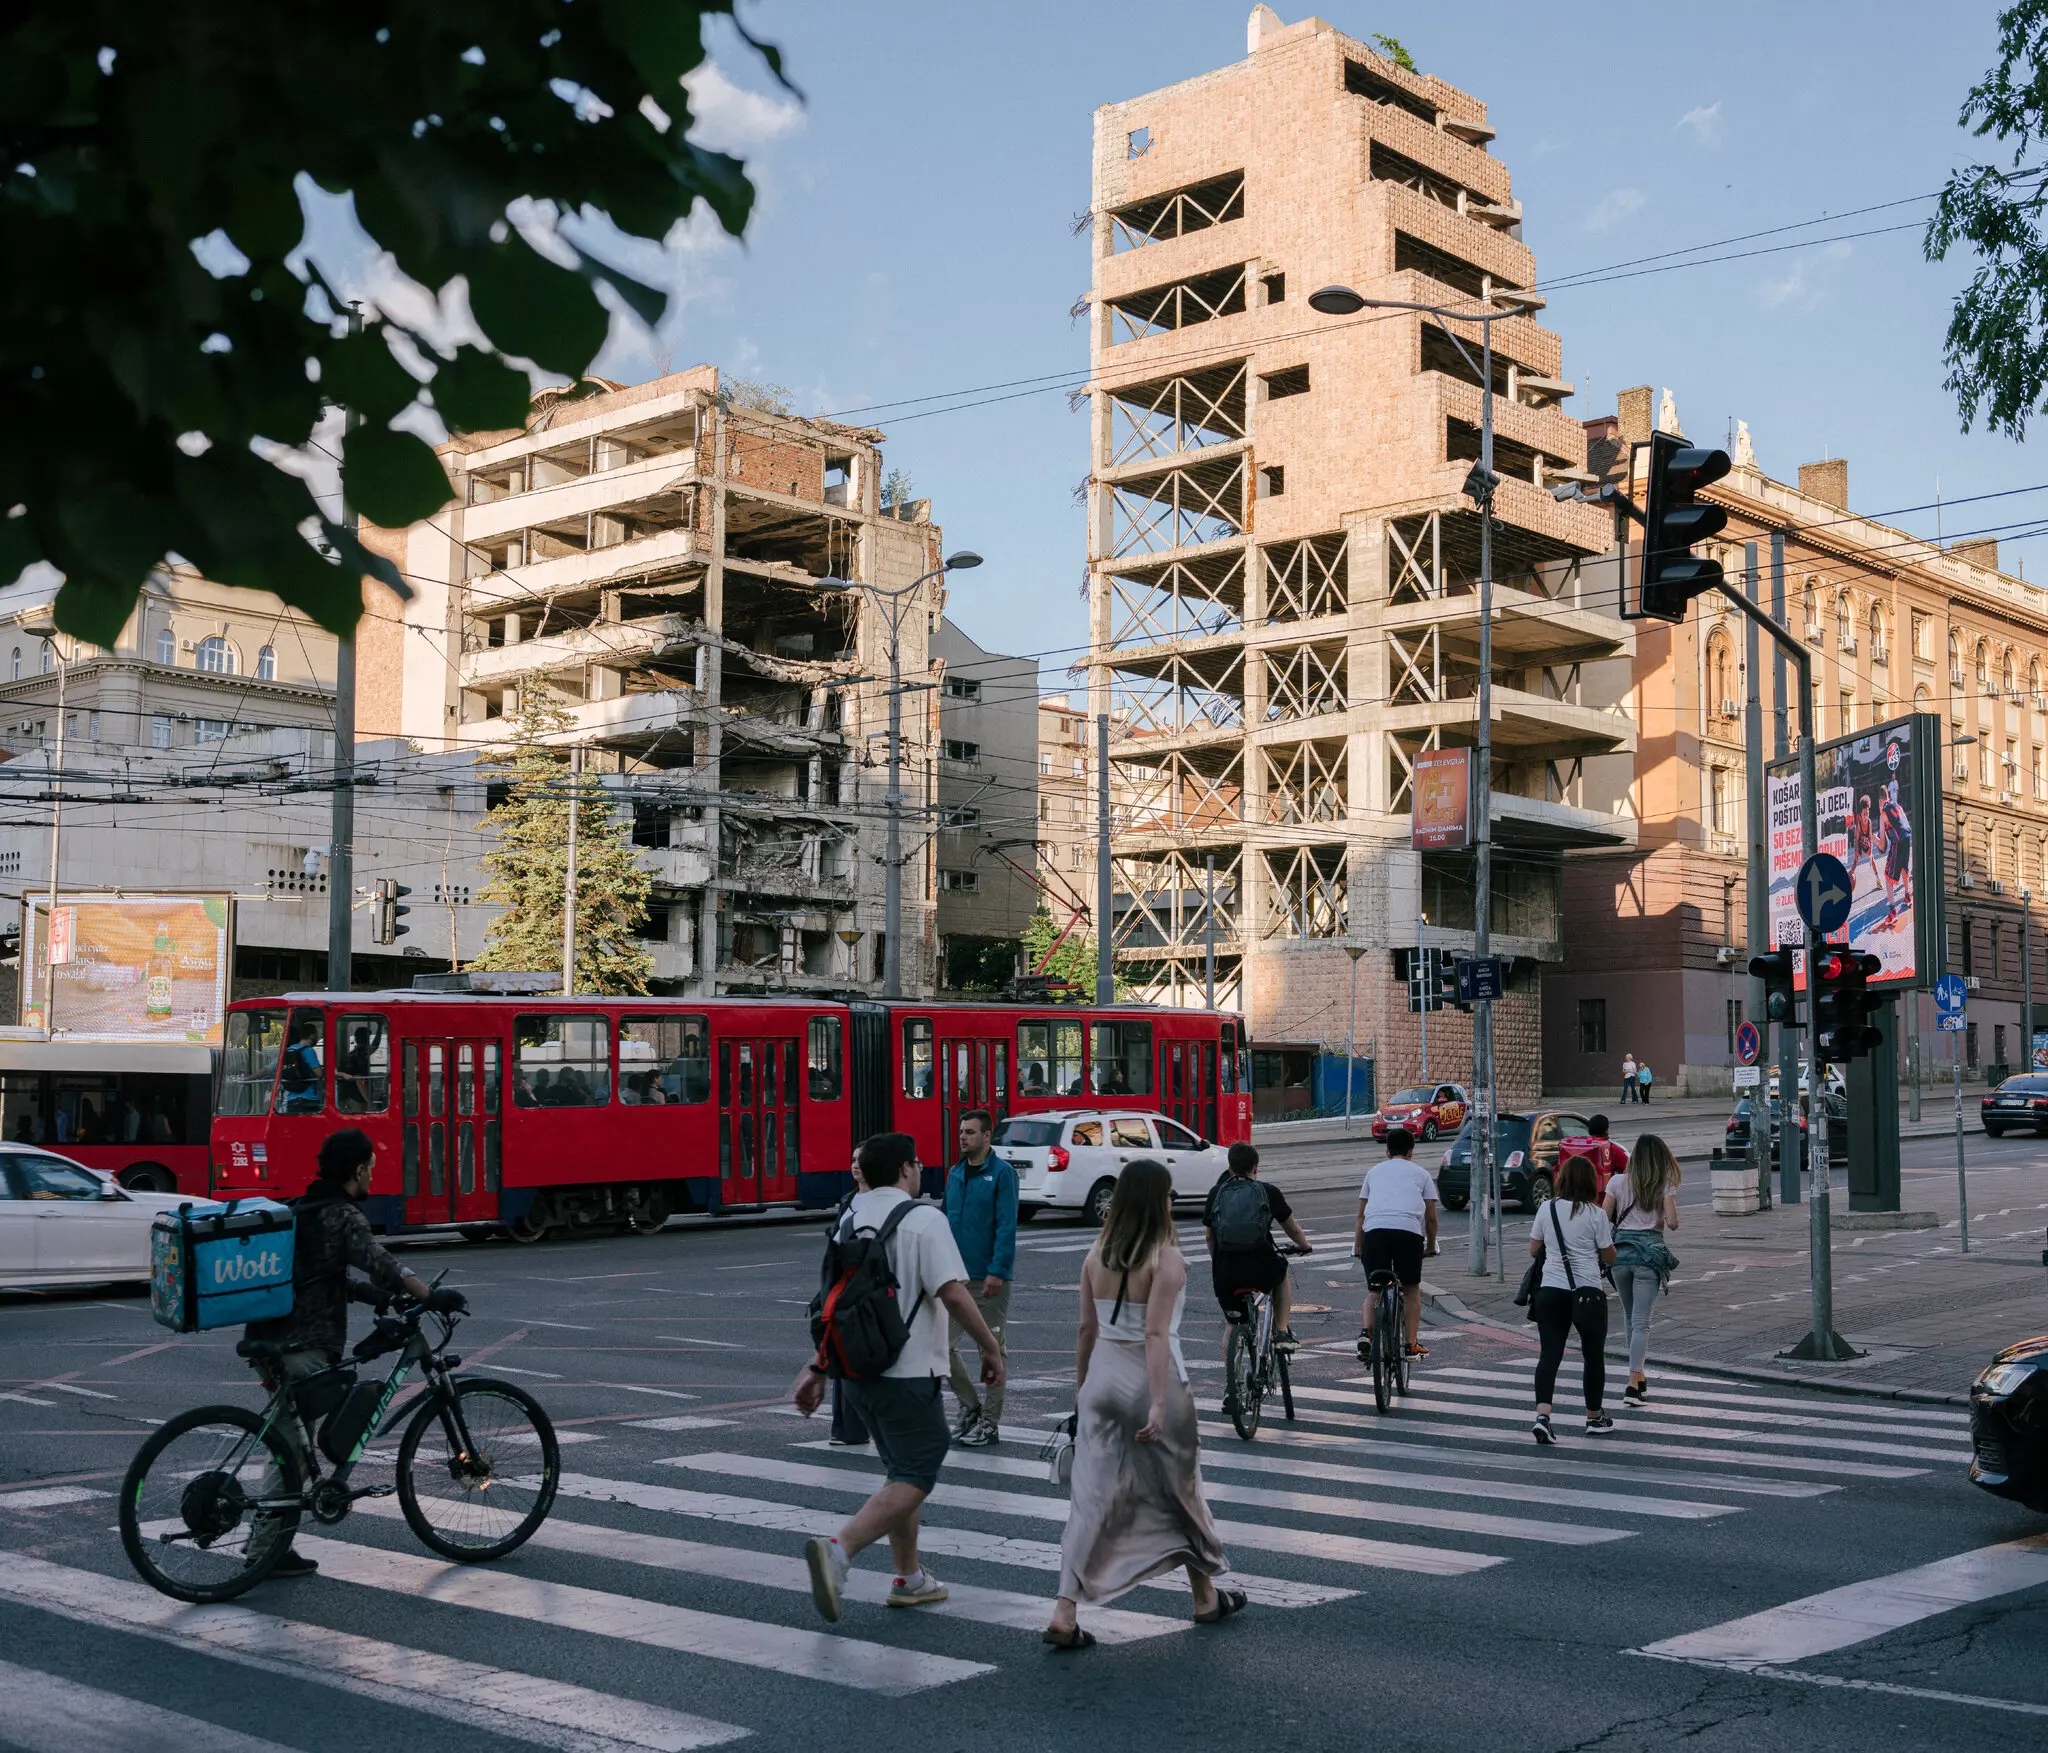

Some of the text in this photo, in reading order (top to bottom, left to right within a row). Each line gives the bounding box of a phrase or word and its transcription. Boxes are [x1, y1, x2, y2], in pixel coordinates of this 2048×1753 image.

[1773, 782, 1800, 806] KOŠAR
[1828, 792, 1850, 812] DECI,
[1438, 824, 1464, 832] DANIMA
[1774, 828, 1802, 850] 50 SEZ
[215, 1252, 282, 1283] Wolt
